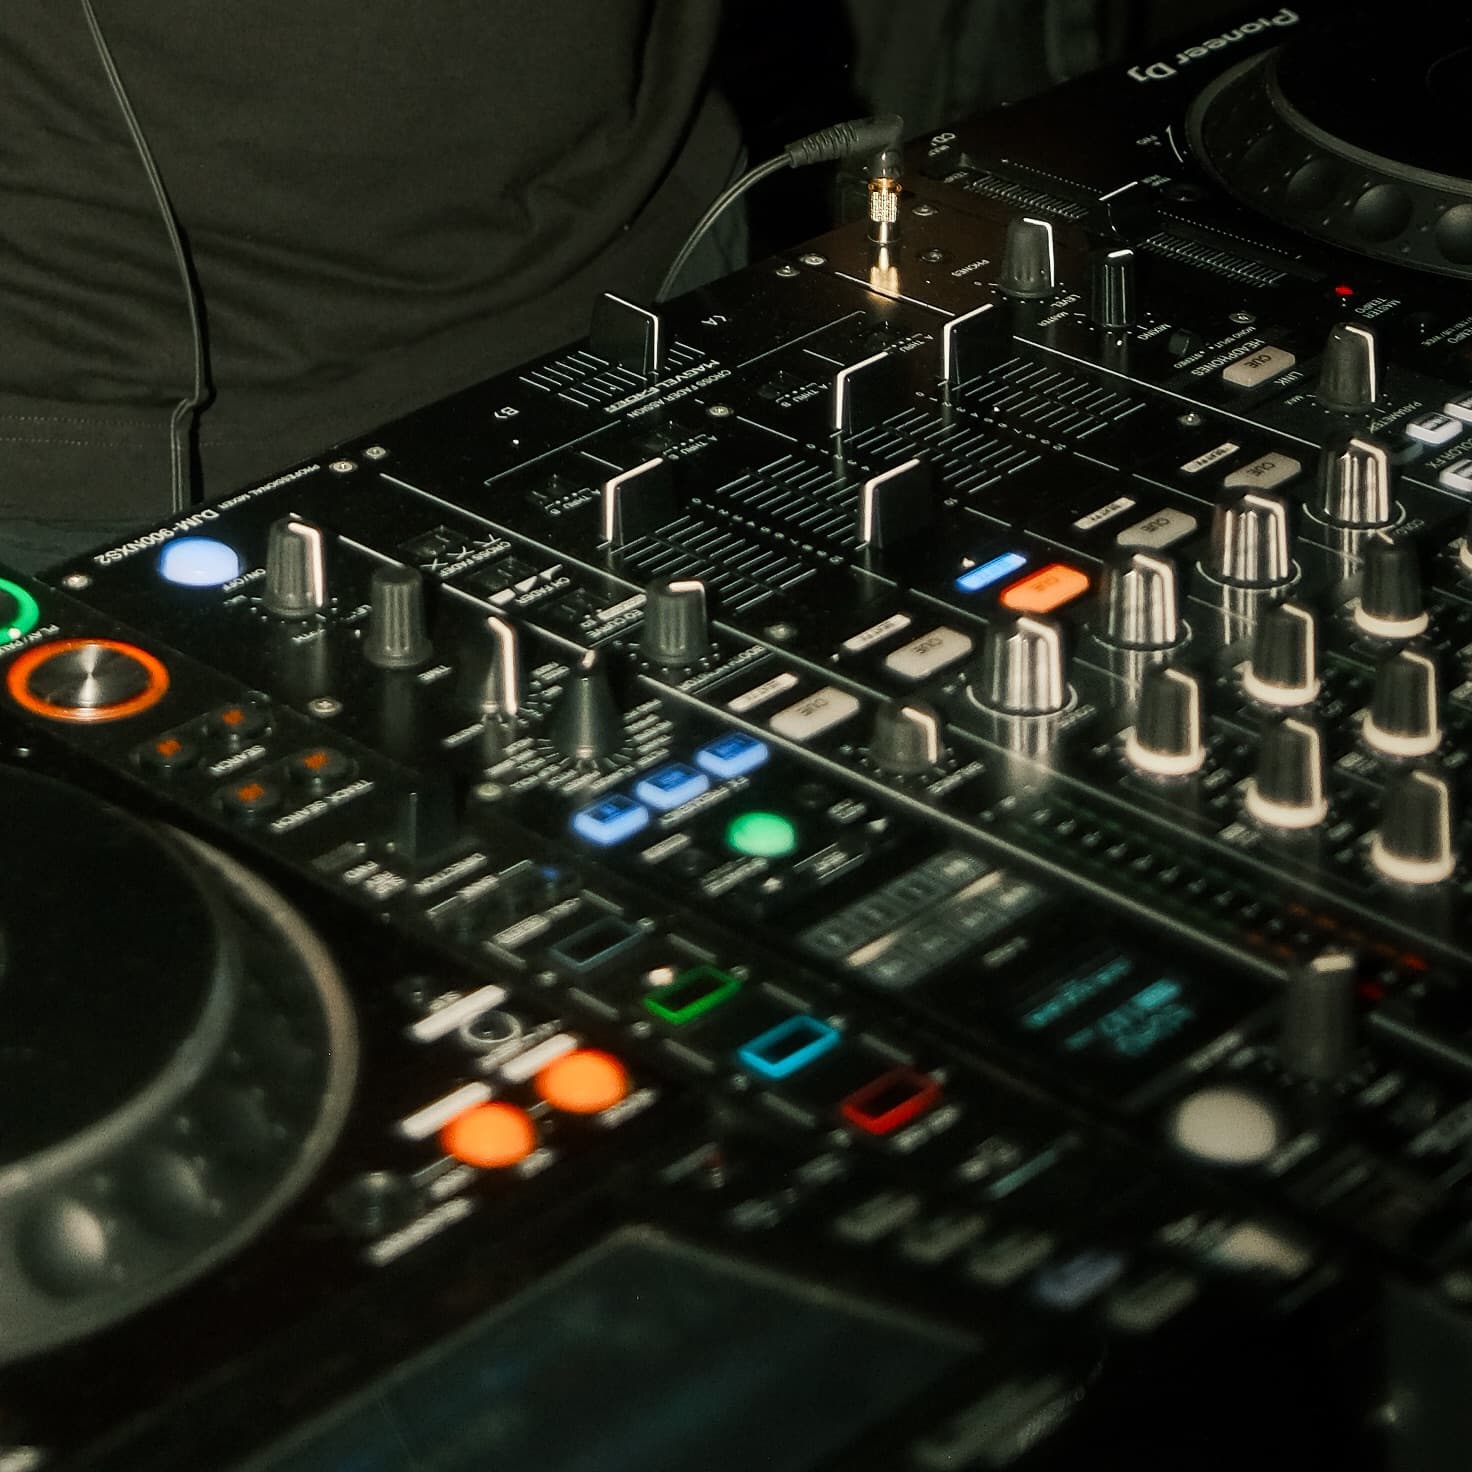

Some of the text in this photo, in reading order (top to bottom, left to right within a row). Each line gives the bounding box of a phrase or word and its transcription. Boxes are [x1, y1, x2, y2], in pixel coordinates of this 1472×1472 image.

[1126, 8, 1301, 84] Pioneer DJ
[1191, 339, 1264, 376] HEADPHONES
[1244, 355, 1272, 368] CUE
[1274, 371, 1304, 385] LINK
[1246, 461, 1275, 476] CUE
[1140, 517, 1170, 532] CUE
[94, 509, 219, 565] DJM-900NXS2
[913, 639, 942, 654] CUE
[797, 699, 828, 716] CUE
